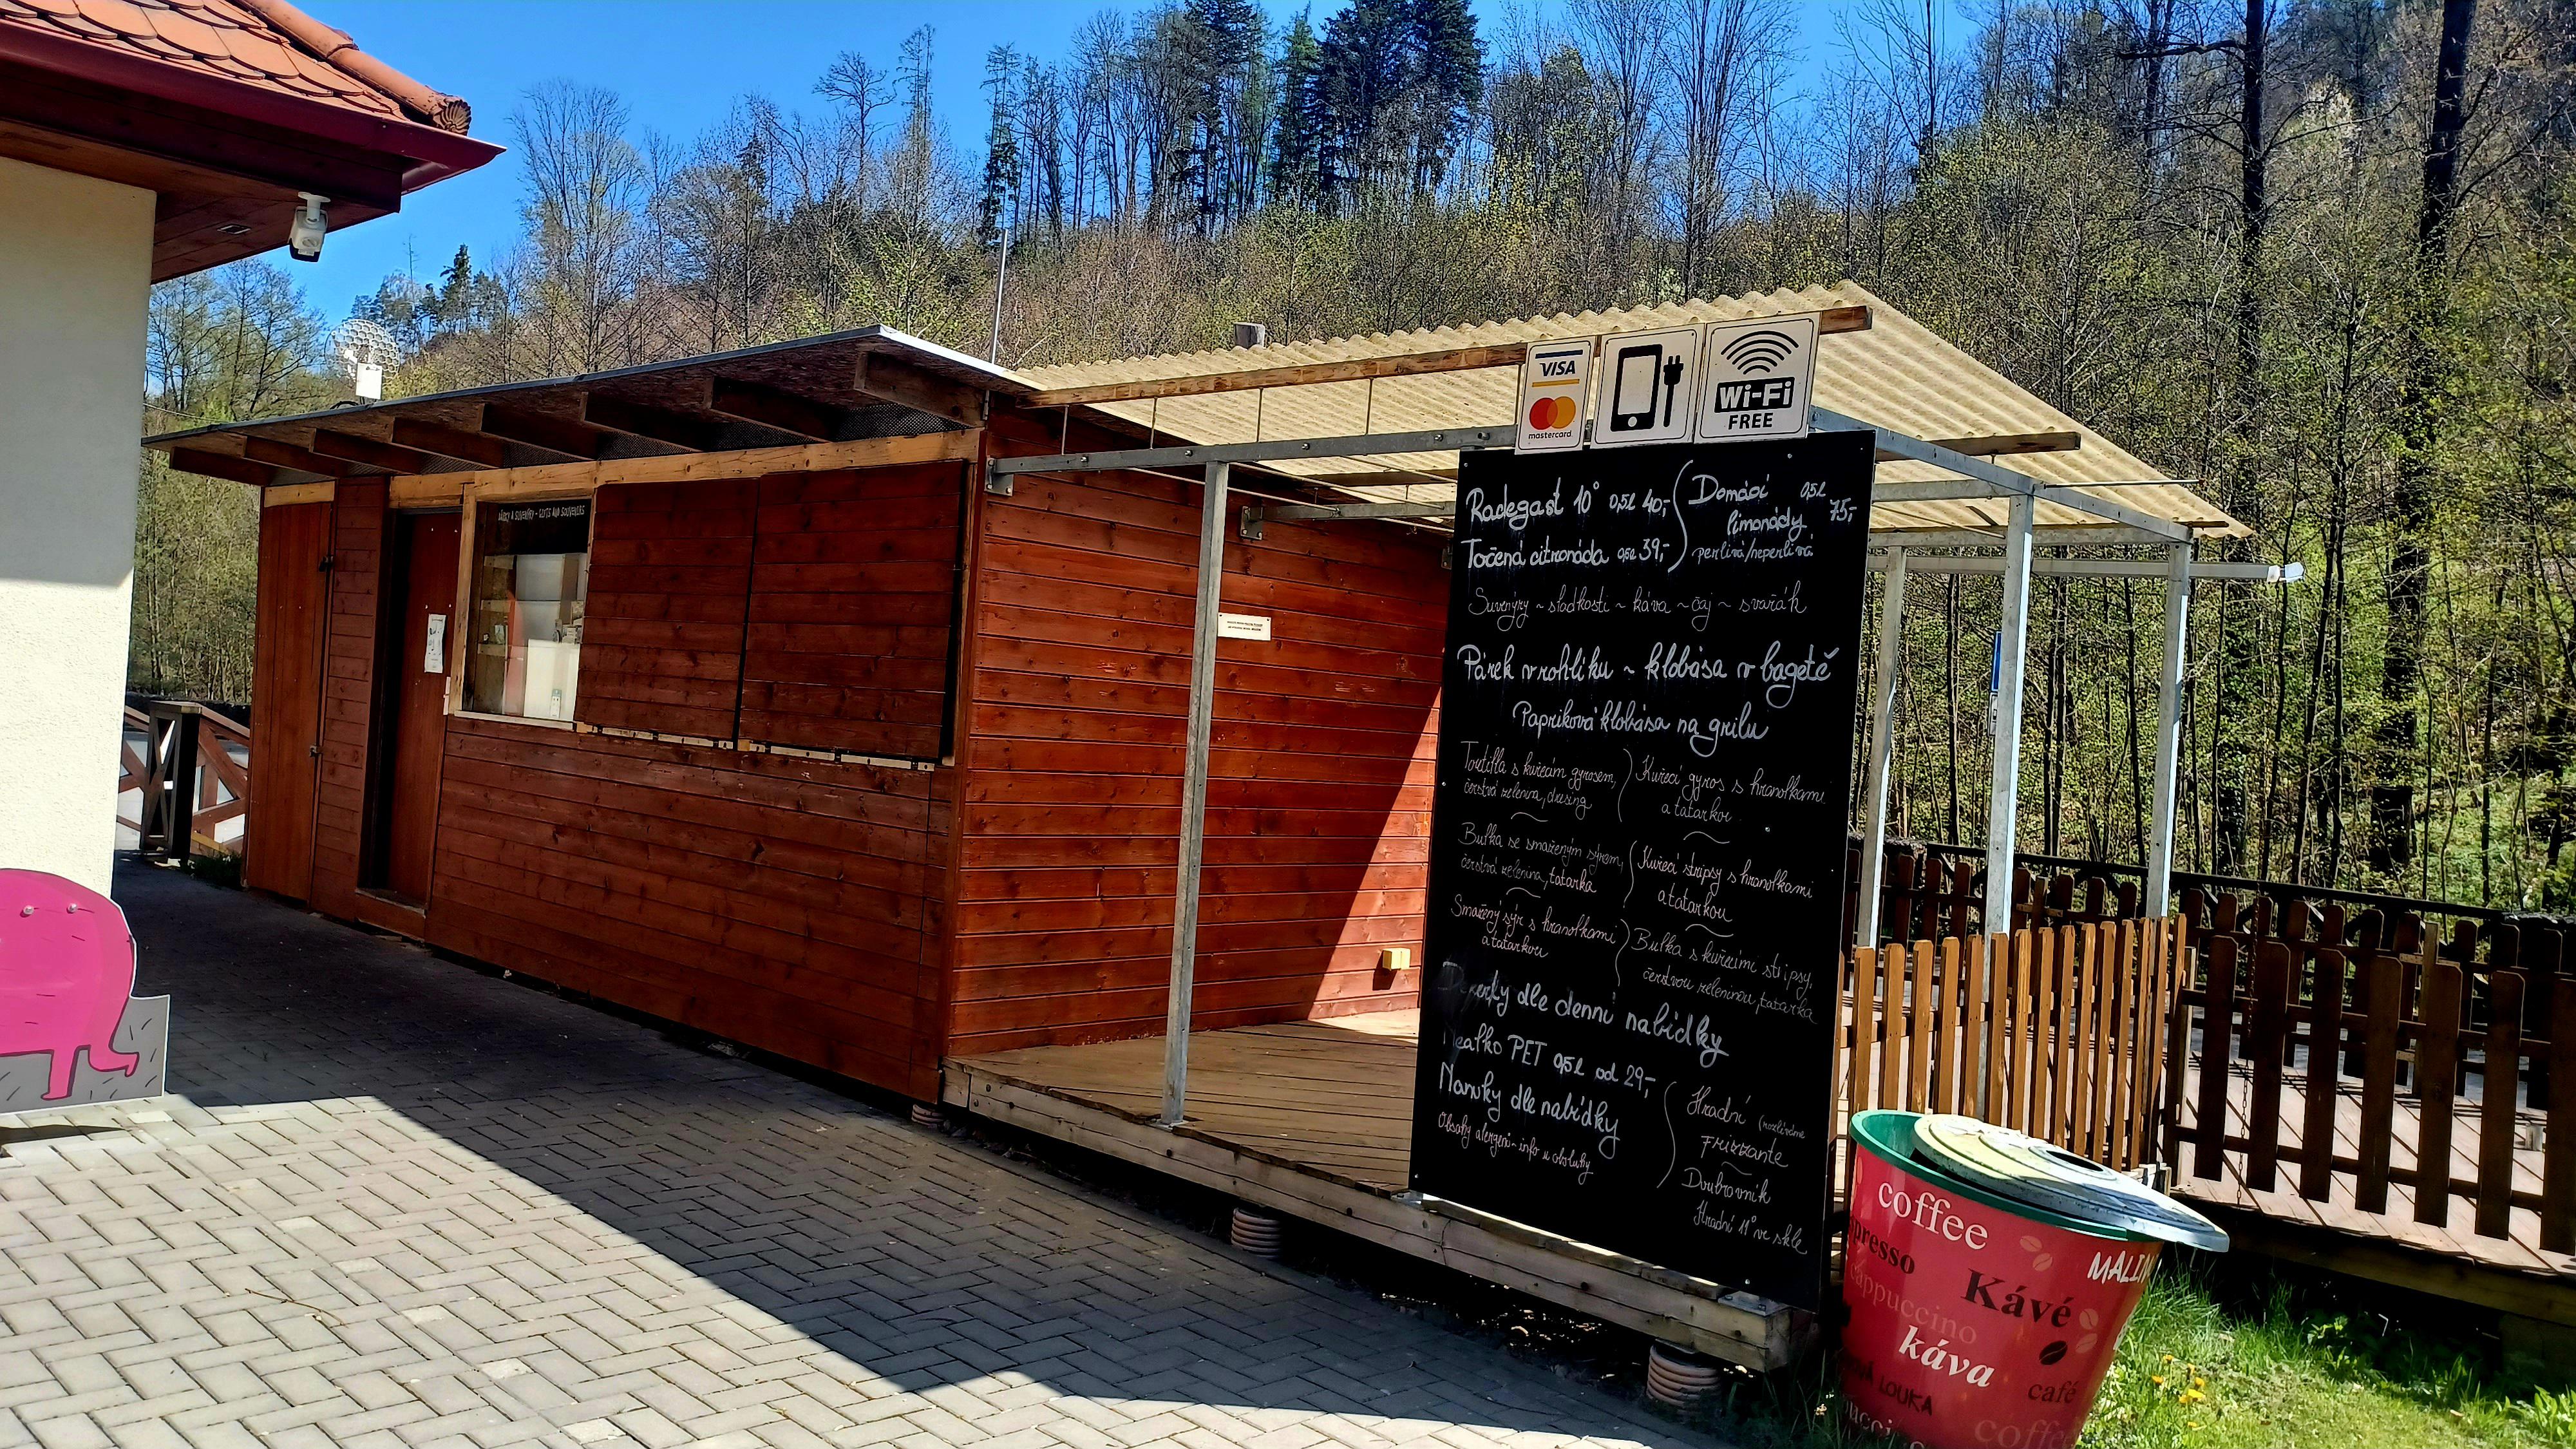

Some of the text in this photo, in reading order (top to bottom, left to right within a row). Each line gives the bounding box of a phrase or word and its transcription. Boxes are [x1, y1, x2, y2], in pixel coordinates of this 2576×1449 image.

[1539, 360, 1576, 377] VISA
[1719, 380, 1792, 410] Wi-Fi
[1528, 429, 1573, 440] mastercard
[1727, 412, 1774, 430] FREE
[1466, 477, 1564, 531] Radegast
[1689, 474, 1769, 504] Domácí
[1727, 506, 1808, 542] limonády
[1461, 535, 1526, 569] Točená
[1530, 535, 1609, 566] citronáda
[1468, 580, 1806, 632] Suvenýry sladkosti káva čaj svařák
[1457, 644, 1514, 681] Párek
[1644, 641, 1727, 680] klobása
[1738, 662, 1756, 678] v
[1760, 640, 1840, 708] bagetě
[1513, 699, 1768, 757] Papriková klobása na grilu
[1461, 741, 1507, 774] Tortilla
[1511, 762, 1519, 776] s
[1636, 754, 1826, 804] Kuřecí gyros s hranolkami
[1464, 778, 1499, 797] čerstvá
[1662, 804, 1671, 815] a
[1457, 822, 1503, 848] Bulka
[1508, 837, 1520, 849] se
[1526, 838, 1582, 867] smaženým
[1461, 853, 1497, 875] čerstvá
[1549, 867, 1597, 893] tatarka
[1638, 846, 1814, 898] Kuřecí stripsy s hranolkami
[1451, 894, 1618, 944] Smažený sýr s hranolkami
[1658, 883, 1733, 922] a tatarkou
[1482, 931, 1548, 958] a tatarkou
[1631, 927, 1682, 956] Bulka
[1689, 949, 1698, 961] s
[1643, 965, 1694, 989] čerstvou
[1761, 992, 1817, 1025] tatarka
[1517, 983, 1548, 1012] dle
[1555, 990, 1616, 1025] denní
[1625, 1002, 1729, 1068] nabídky
[1443, 1022, 1502, 1055] Nealko
[1507, 1034, 1548, 1066] PET
[1596, 1063, 1618, 1082] od
[1439, 1062, 1620, 1159] Nanuky dle nabídky
[1687, 1085, 1751, 1124] Hradní
[1438, 1112, 1472, 1149] Obsahy
[1519, 1137, 1540, 1162] info
[1542, 1151, 1550, 1160] u
[1552, 1148, 1594, 1185] obsluhy
[1701, 1134, 1788, 1168] Frizzante
[1693, 1199, 1735, 1233] Hradní
[1753, 1229, 1771, 1240] ve
[1772, 1224, 1808, 1255] skle
[1879, 1182, 1988, 1250] coffee
[1850, 1262, 1977, 1344] cappuccino
[1961, 1268, 2074, 1327] Kávé
[1899, 1325, 1995, 1387] káva
[1879, 1375, 1933, 1416] LOUKA
[2028, 1381, 2079, 1403] café
